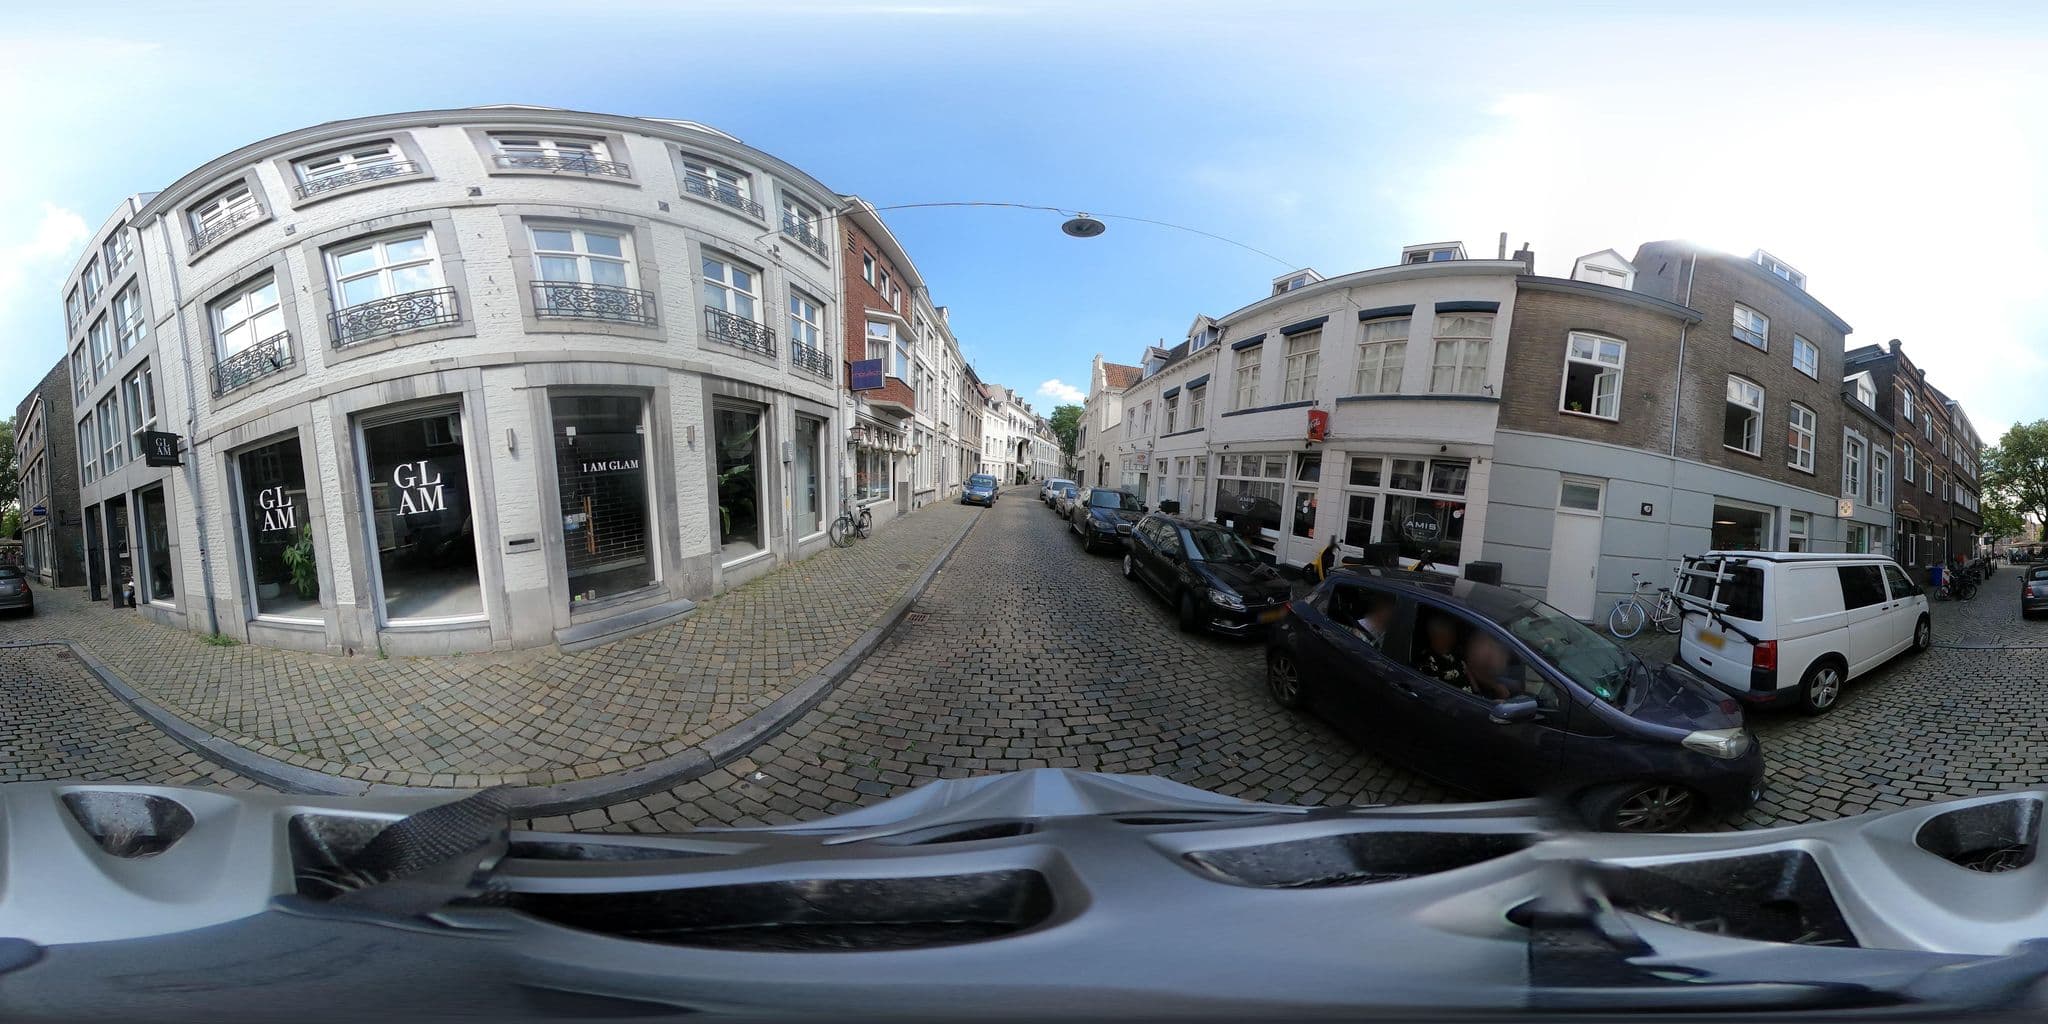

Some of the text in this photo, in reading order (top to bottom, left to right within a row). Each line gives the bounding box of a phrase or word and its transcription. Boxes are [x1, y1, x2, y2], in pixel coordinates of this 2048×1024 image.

[155, 438, 170, 447] GL
[156, 446, 172, 455] AM
[393, 460, 441, 489] GL
[583, 459, 639, 472] I AM GLAM
[259, 486, 292, 510] GL
[396, 485, 448, 516] AM
[263, 507, 297, 531] AM
[1406, 520, 1437, 531] AMIS
